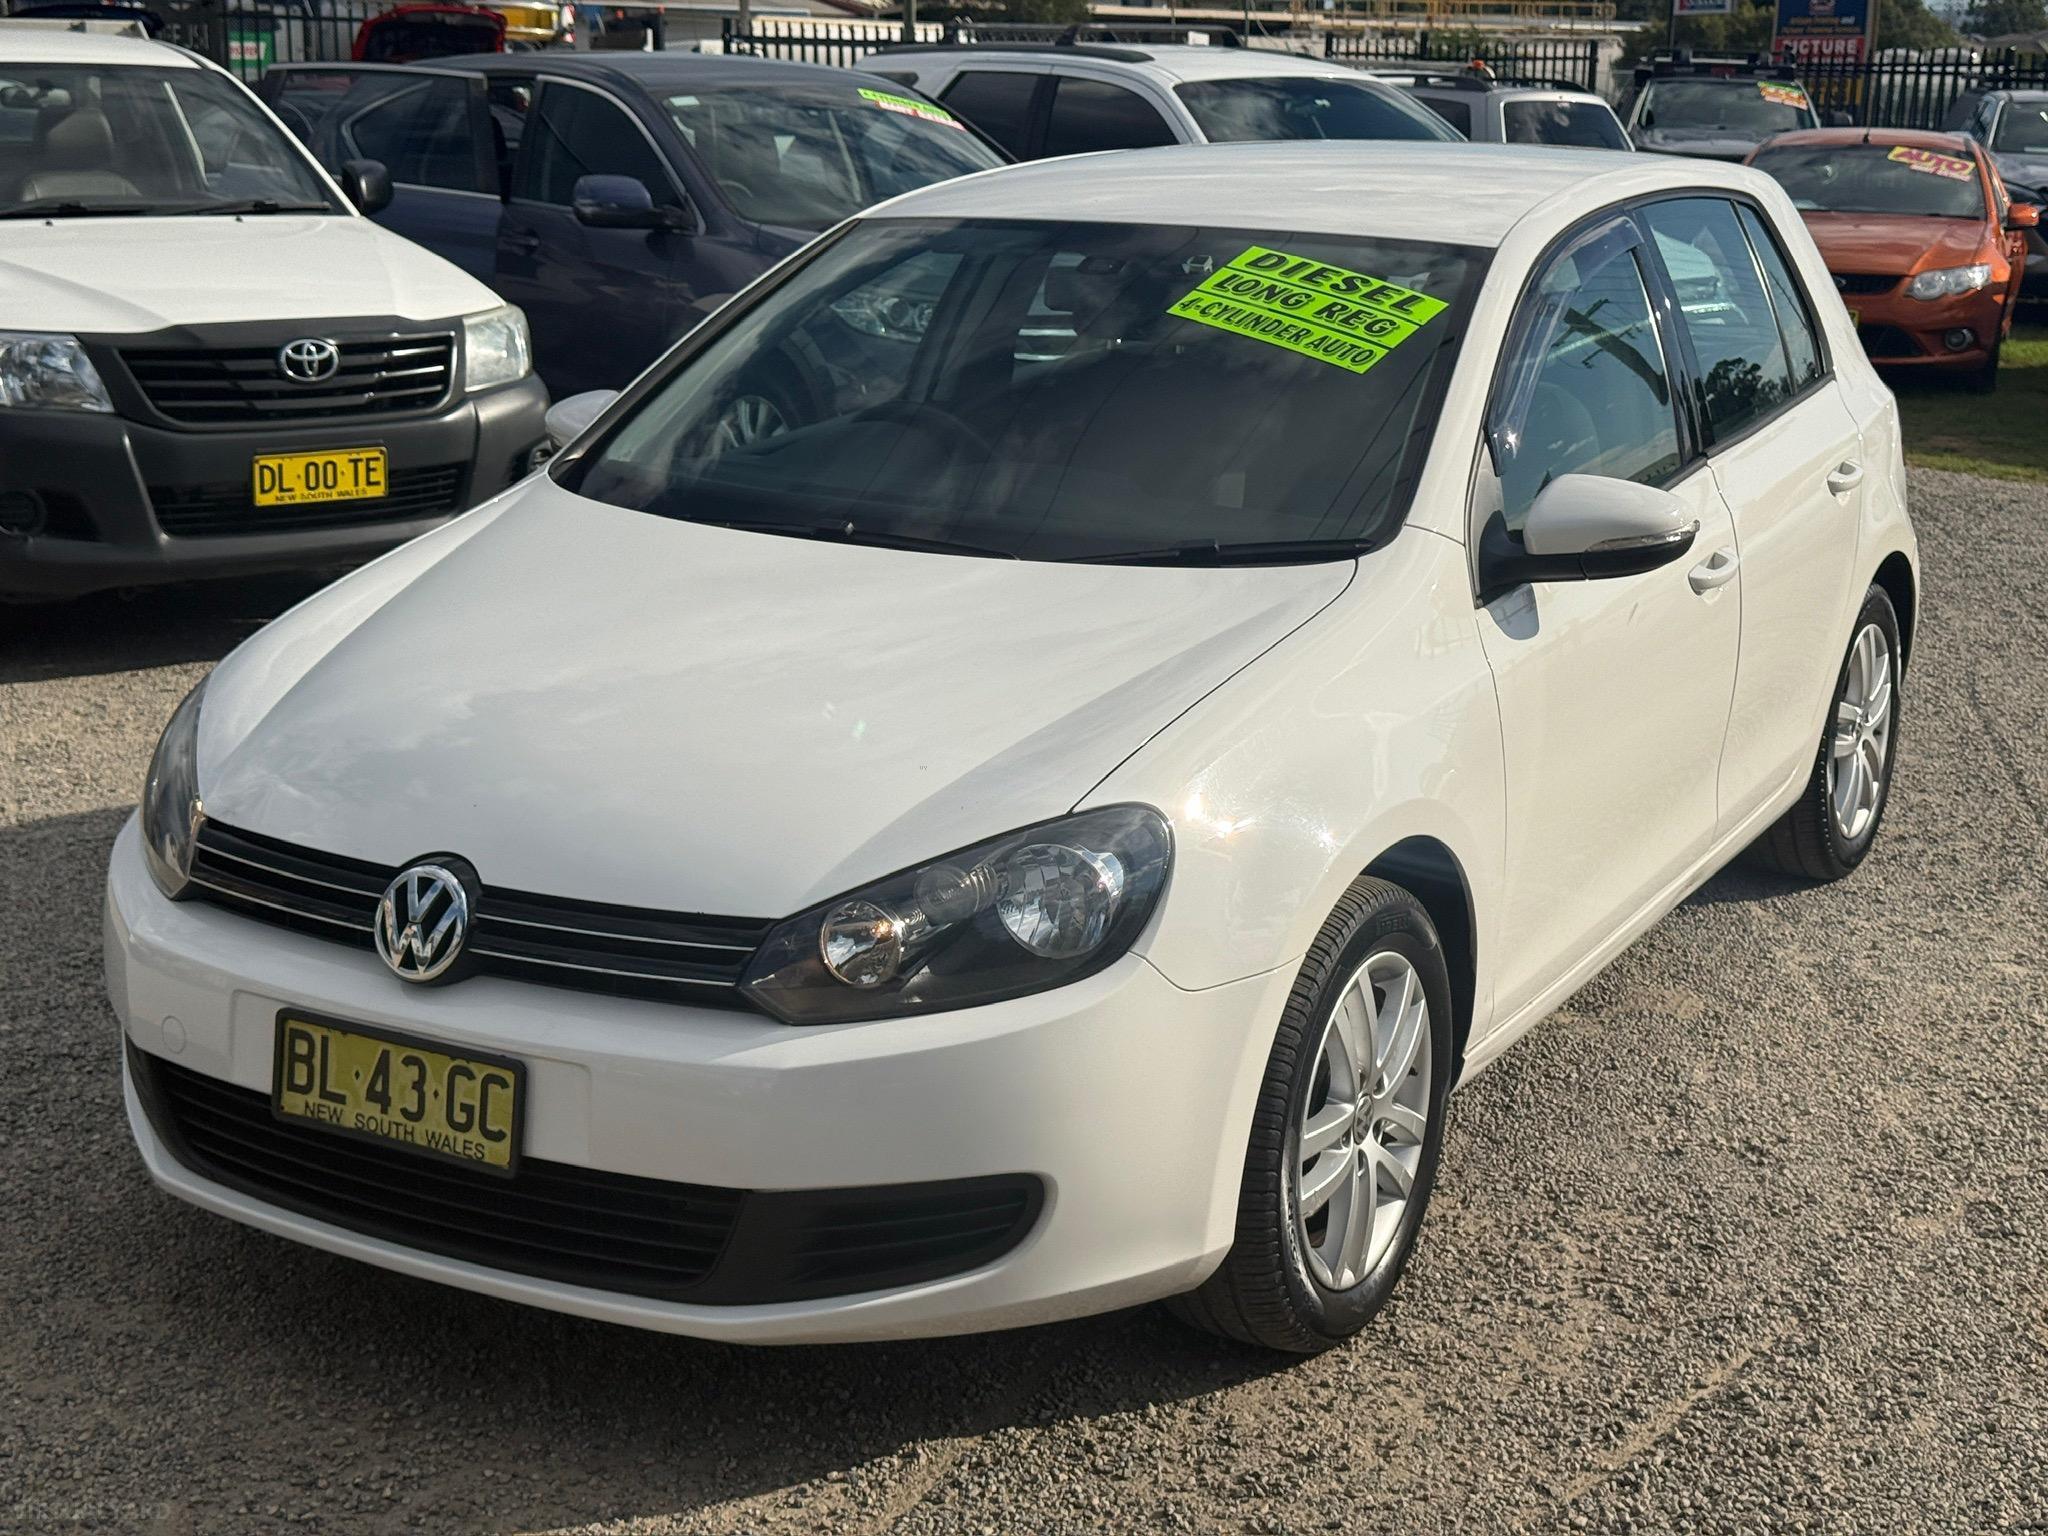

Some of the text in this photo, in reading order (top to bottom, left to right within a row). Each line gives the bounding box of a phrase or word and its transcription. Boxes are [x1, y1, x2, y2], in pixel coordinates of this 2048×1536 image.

[1213, 273, 1399, 337] LONG REG
[1244, 252, 1426, 315] DIESEL
[1179, 296, 1377, 366] 4-CYLINDER AUTO
[304, 1101, 486, 1161] NEW SOUTH WALES
